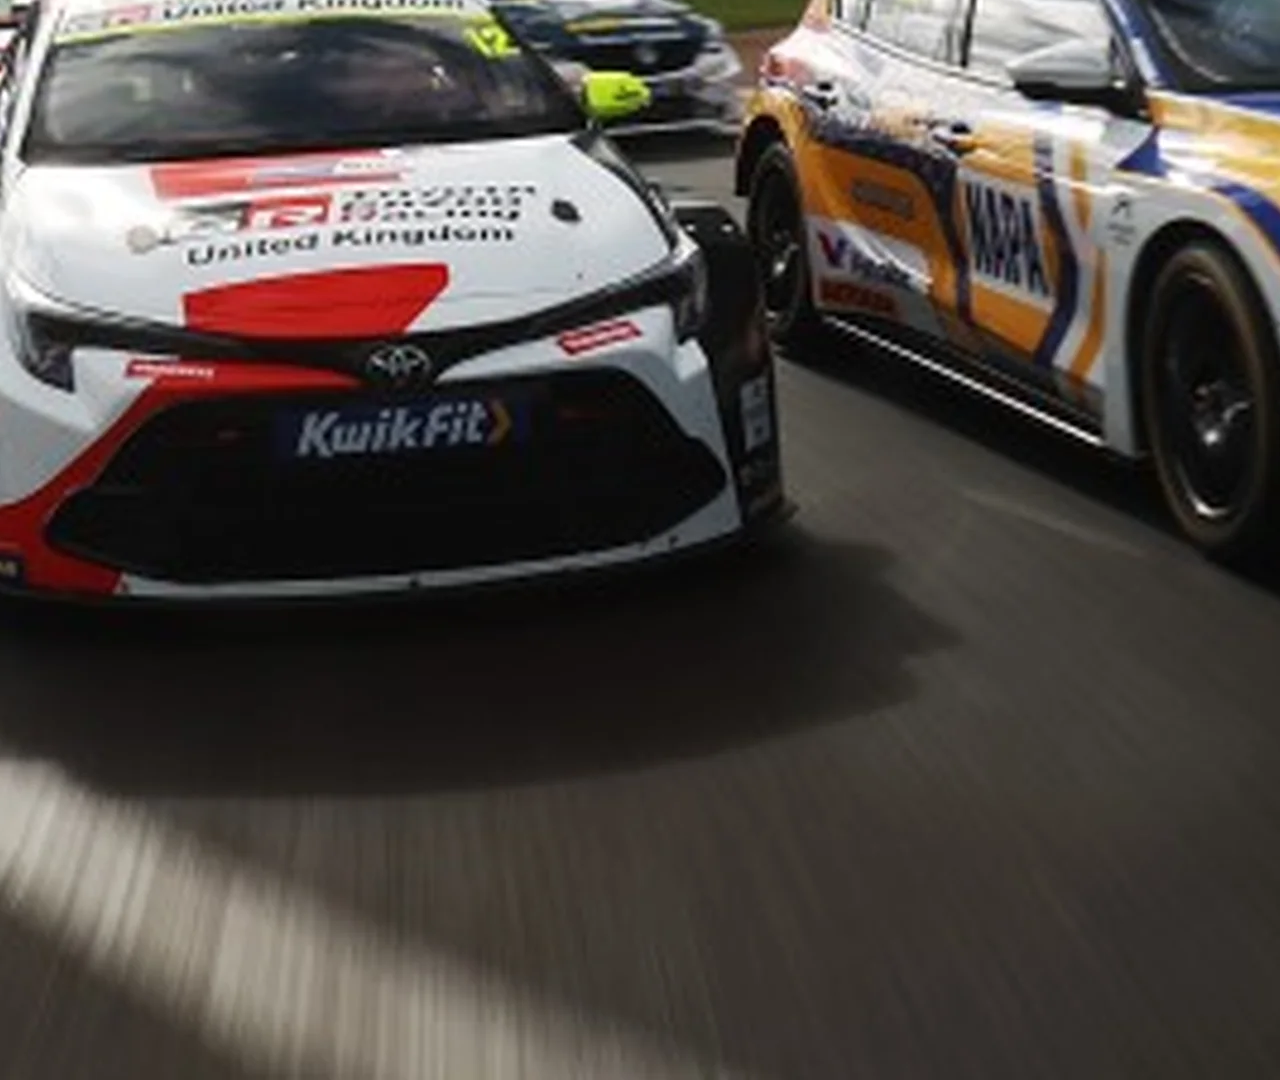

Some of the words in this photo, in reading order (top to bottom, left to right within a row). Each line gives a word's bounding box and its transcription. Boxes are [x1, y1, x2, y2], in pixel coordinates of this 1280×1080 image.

[187, 234, 321, 266] United
[331, 222, 515, 248] Kingdom
[963, 178, 1052, 298] NAPA
